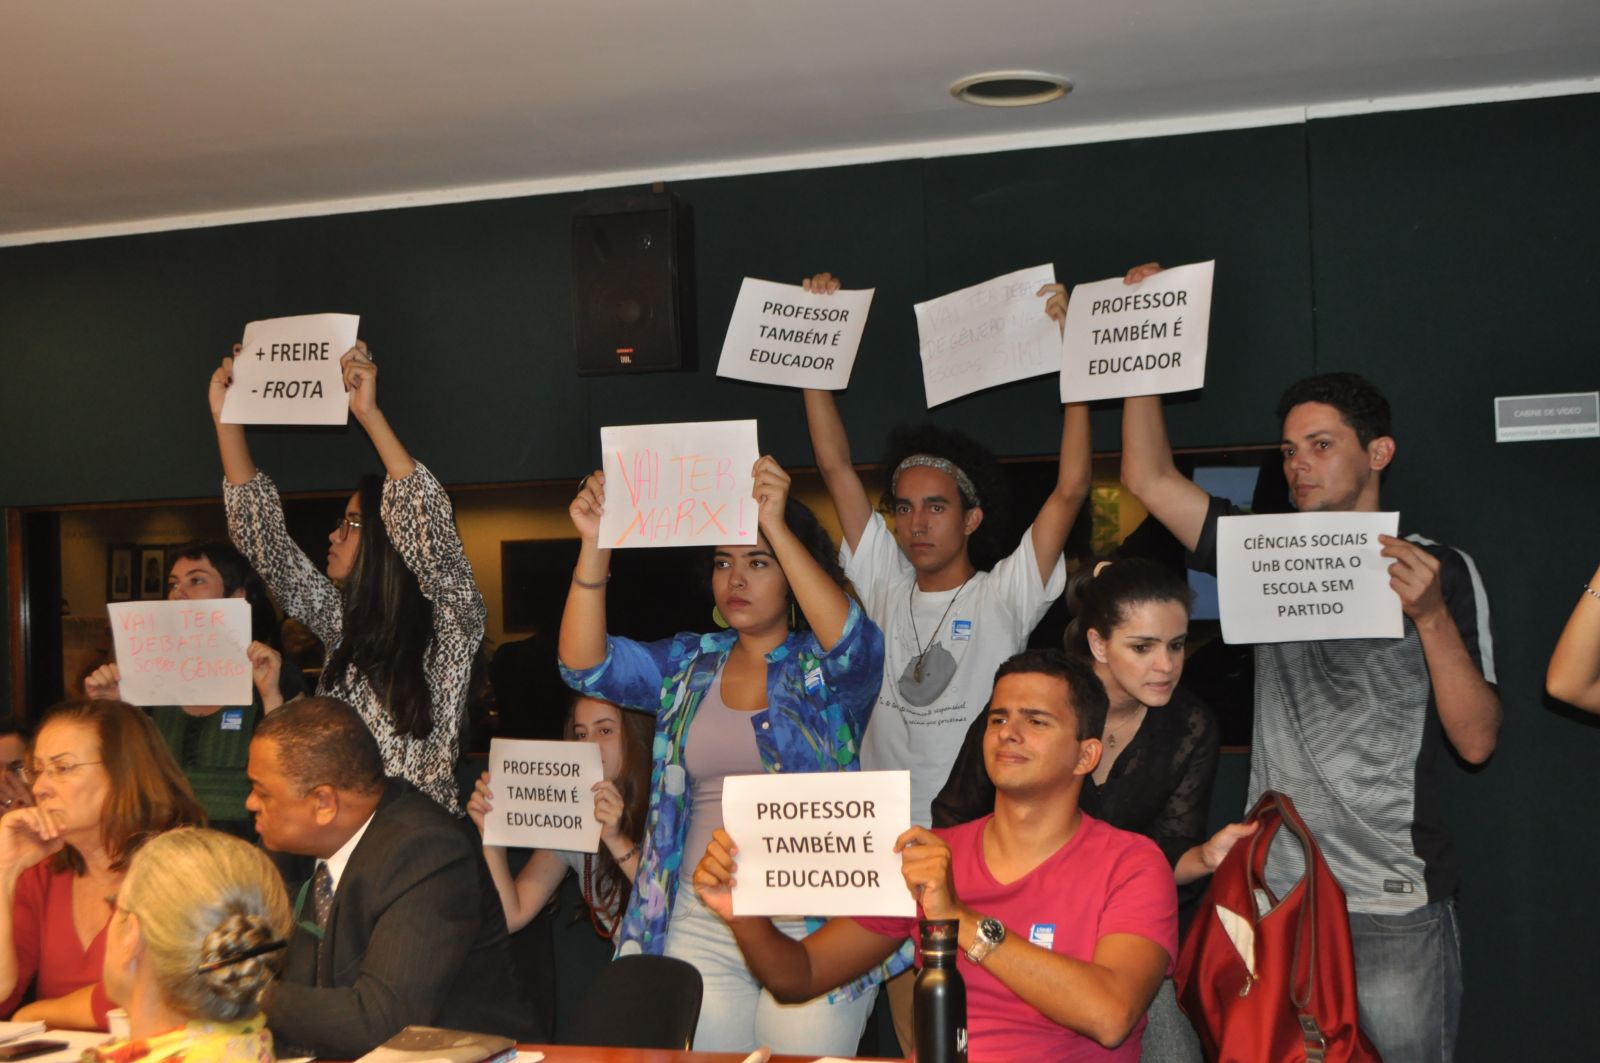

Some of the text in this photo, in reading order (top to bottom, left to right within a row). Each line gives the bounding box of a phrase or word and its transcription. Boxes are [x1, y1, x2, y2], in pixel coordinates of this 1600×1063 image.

[762, 301, 849, 322] PROFESSOR
[1092, 290, 1187, 315] PROFESSOR
[760, 325, 841, 346] TAMBÉM É
[1092, 316, 1183, 345] TAMBÉM É
[271, 342, 330, 361] FREIRE
[749, 348, 834, 370] EDUCADOR
[1088, 352, 1181, 376] EDUCADOR
[263, 380, 323, 398] FROTA
[1544, 408, 1555, 416] DE
[616, 448, 736, 508] VAI TER
[1244, 533, 1368, 550] CIÊNCIAS SOCIAIS
[1252, 556, 1361, 572] UnB CONTRA O
[1263, 579, 1354, 595] ESCOLA SEM
[1278, 602, 1343, 617] PARTIDO
[121, 610, 225, 632] VAI TER
[128, 634, 218, 656] DEBATE
[503, 760, 580, 777] PROFESSOR
[507, 785, 579, 804] TAMBÉM É
[757, 800, 876, 820] PROFESSOR
[506, 812, 582, 830] EDUCADOR
[762, 830, 875, 853] TAMBÉM É
[765, 869, 880, 888] EDUCADOR
